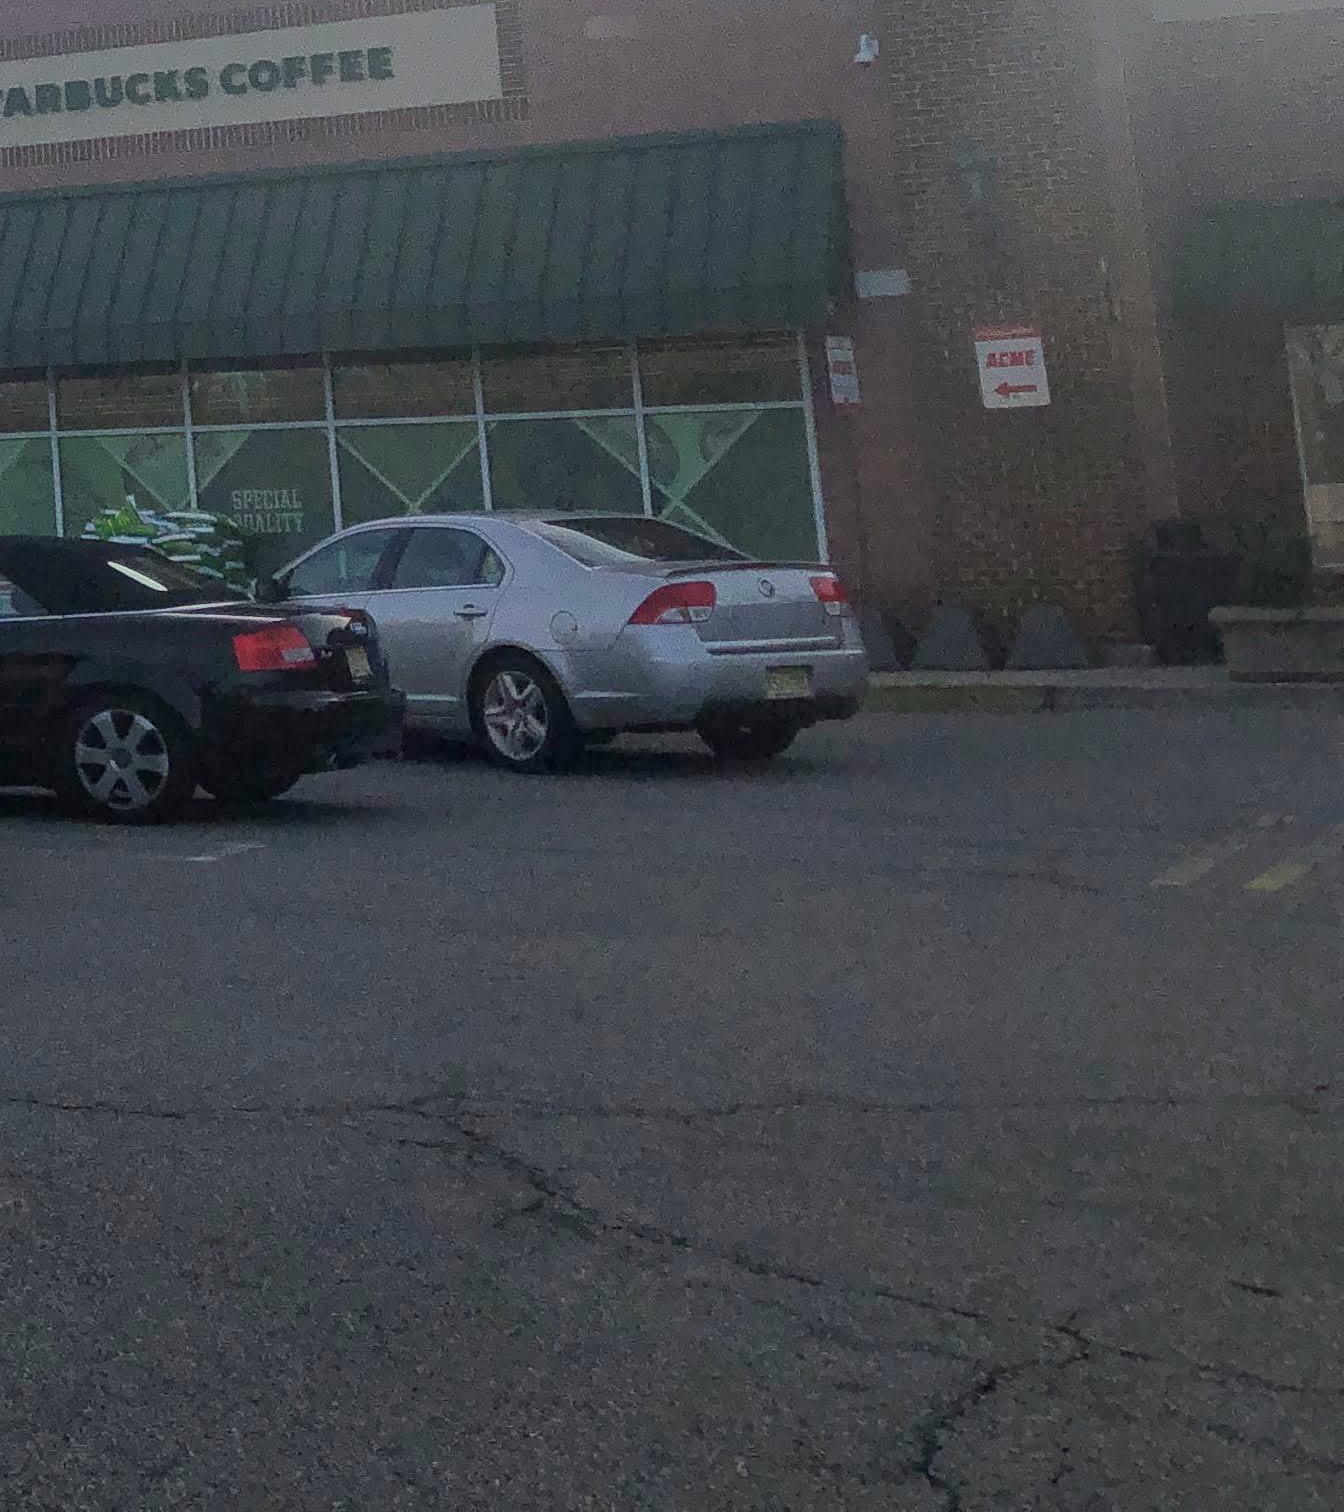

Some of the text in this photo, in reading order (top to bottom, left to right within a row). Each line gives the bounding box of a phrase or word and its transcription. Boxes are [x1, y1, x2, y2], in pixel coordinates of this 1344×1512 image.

[219, 46, 395, 95] COFFEE
[986, 348, 1035, 368] ACME
[232, 487, 303, 510] SPECIAL
